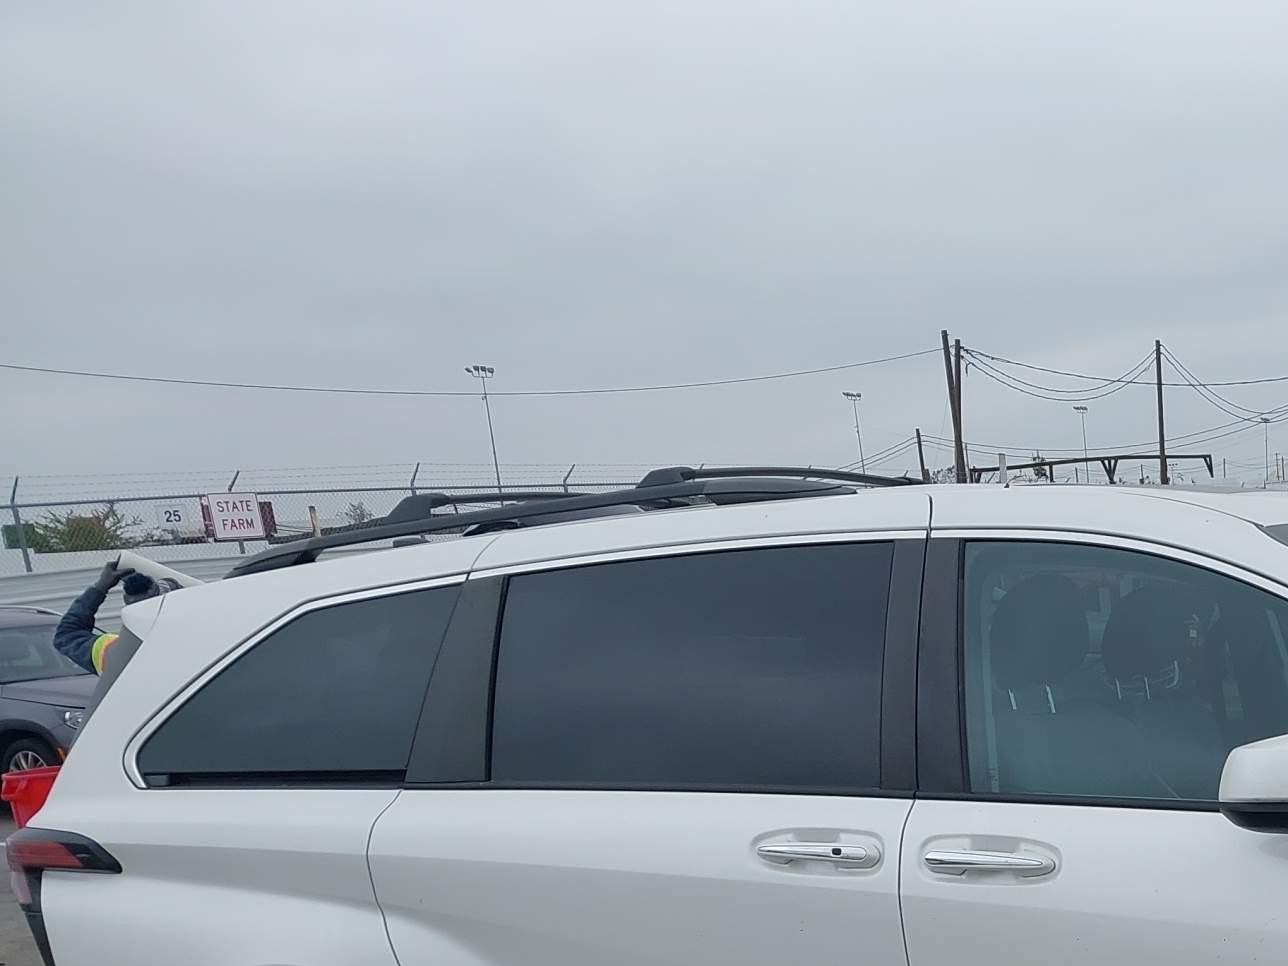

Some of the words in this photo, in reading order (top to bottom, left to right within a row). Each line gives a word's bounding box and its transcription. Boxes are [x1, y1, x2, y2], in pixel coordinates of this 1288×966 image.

[216, 500, 254, 513] STATE
[164, 510, 182, 522] 25
[222, 518, 255, 530] FARM
